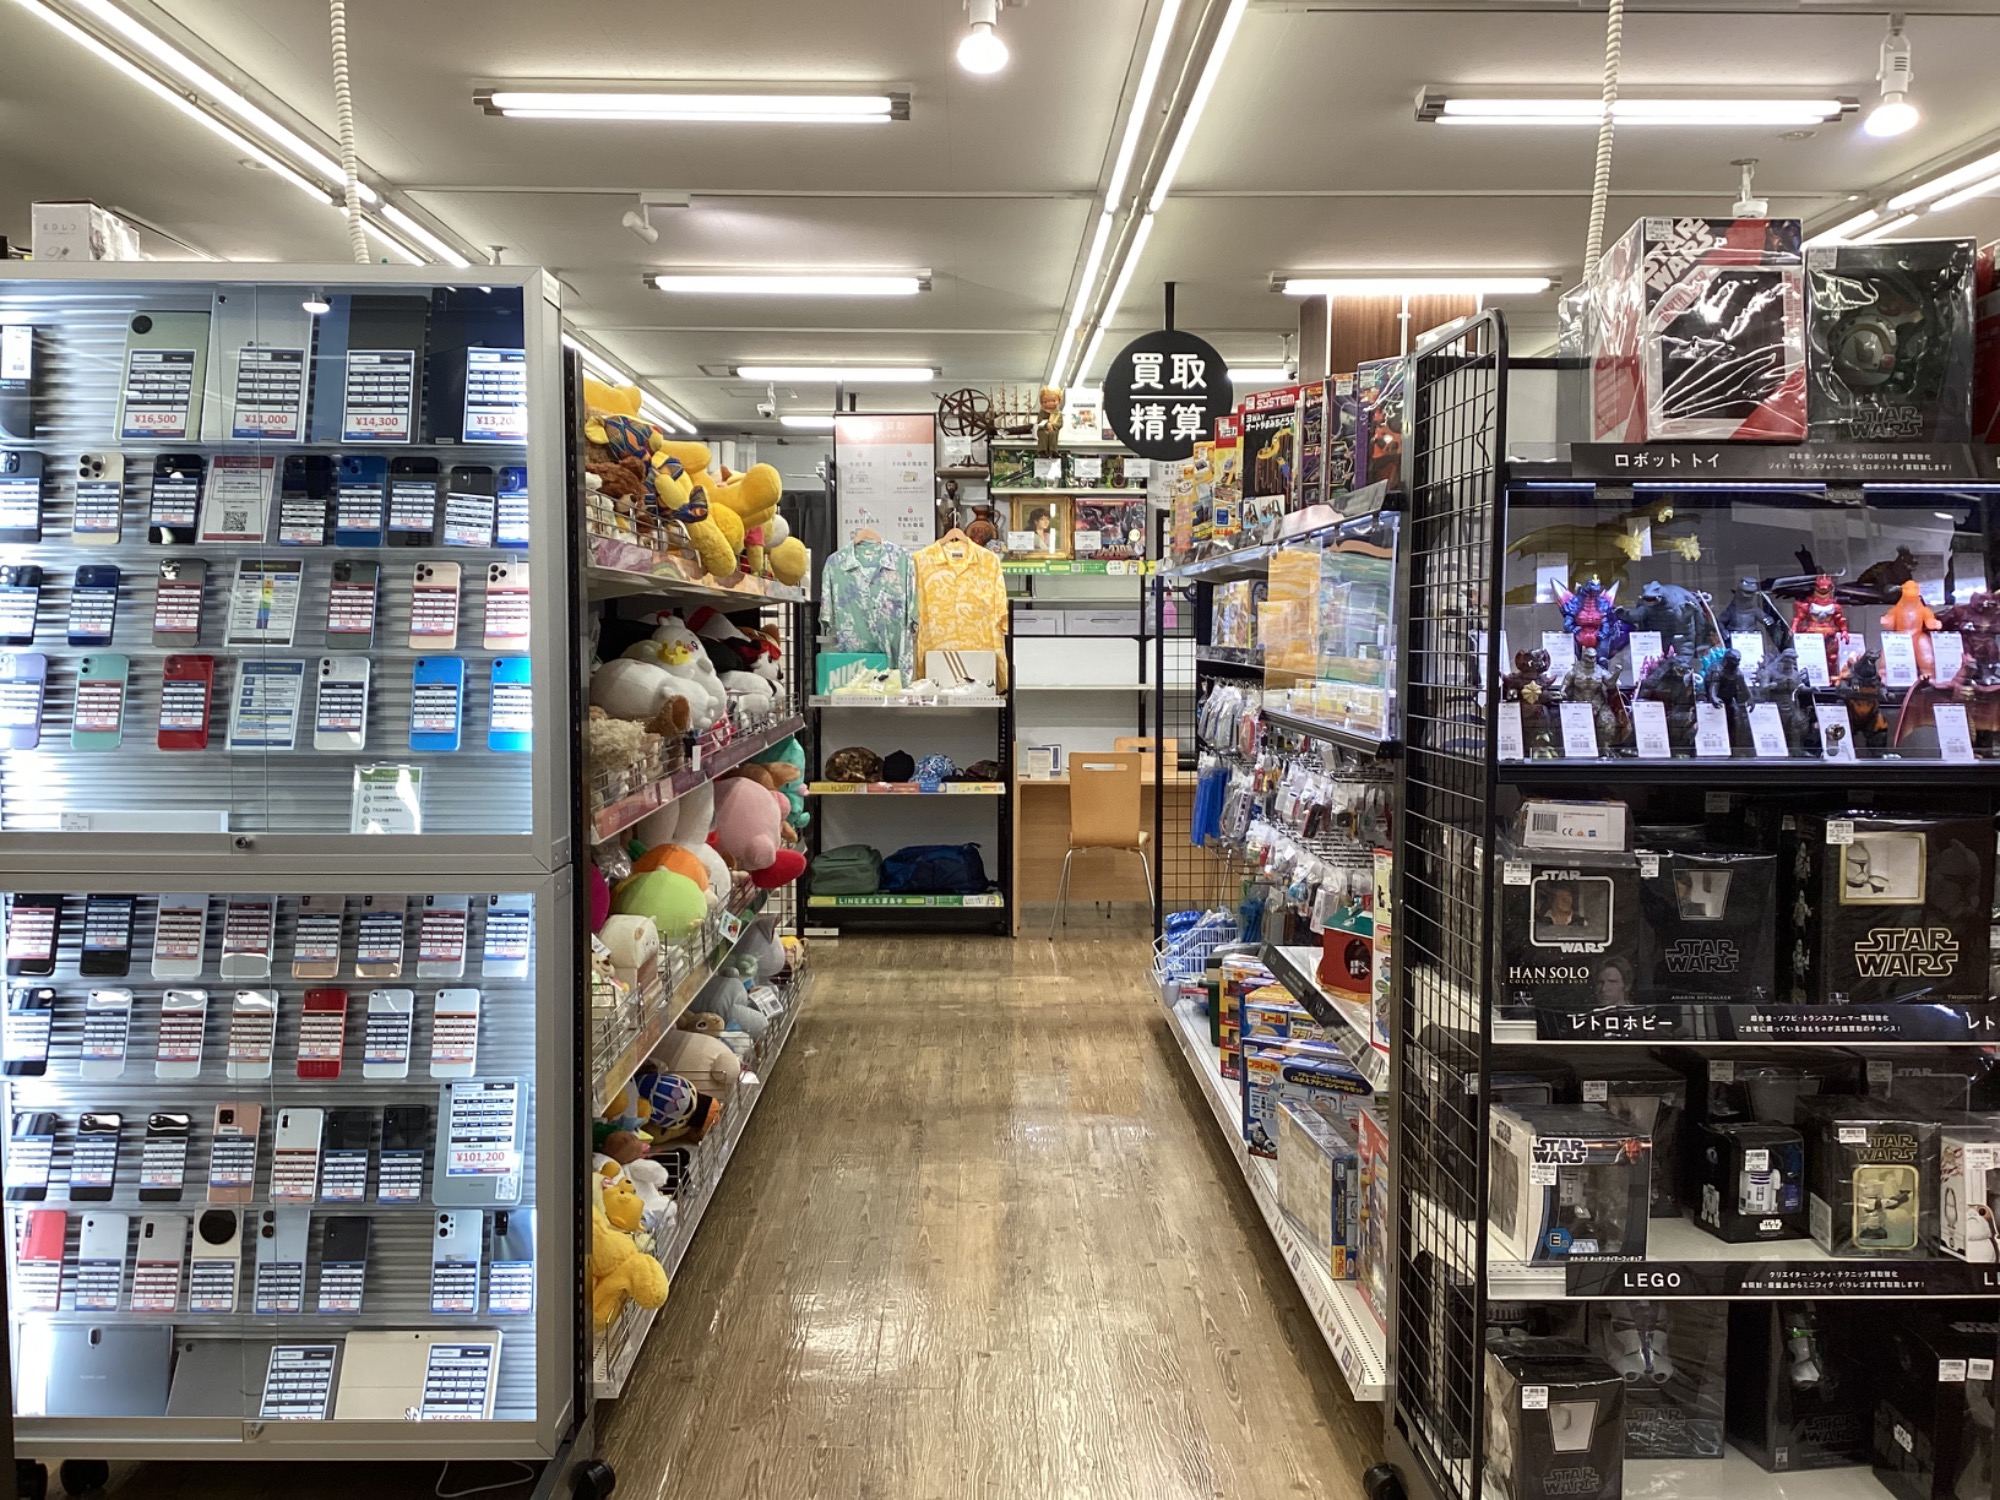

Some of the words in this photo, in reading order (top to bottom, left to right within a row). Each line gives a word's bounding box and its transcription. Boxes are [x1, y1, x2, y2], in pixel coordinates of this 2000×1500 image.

[1645, 224, 1711, 292] WARS
[1130, 352, 1208, 390] 買取
[134, 414, 177, 425] ¥16,500
[244, 413, 288, 425] ¥11,000
[355, 417, 398, 426] ¥14,300
[1129, 403, 1208, 441] 精算
[1854, 406, 1923, 424] STAR
[1848, 422, 1923, 438] WARS
[1615, 452, 1681, 468] ロボット
[1692, 453, 1720, 468] トイ
[829, 657, 868, 690] NIKE
[1541, 870, 1581, 880] STAR
[1855, 928, 1959, 951] STAR
[1560, 943, 1605, 953] WARS
[1665, 939, 1740, 957] STAR
[1665, 955, 1740, 973] WARS
[1855, 953, 1959, 977] WARS
[1509, 966, 1546, 979] HAN
[1549, 966, 1590, 979] SOLO
[1260, 1012, 1284, 1024] レール
[1572, 1014, 1673, 1032] レトロホビー
[1248, 1059, 1279, 1072] プラレール
[1532, 1139, 1587, 1151] STAR
[456, 1151, 506, 1164] ¥101,200
[1532, 1151, 1587, 1163] WARS
[1856, 1147, 1918, 1162] WARS
[1624, 1272, 1681, 1288] LEGO
[1543, 1467, 1599, 1482] STAR
[1543, 1479, 1599, 1495] WARS
